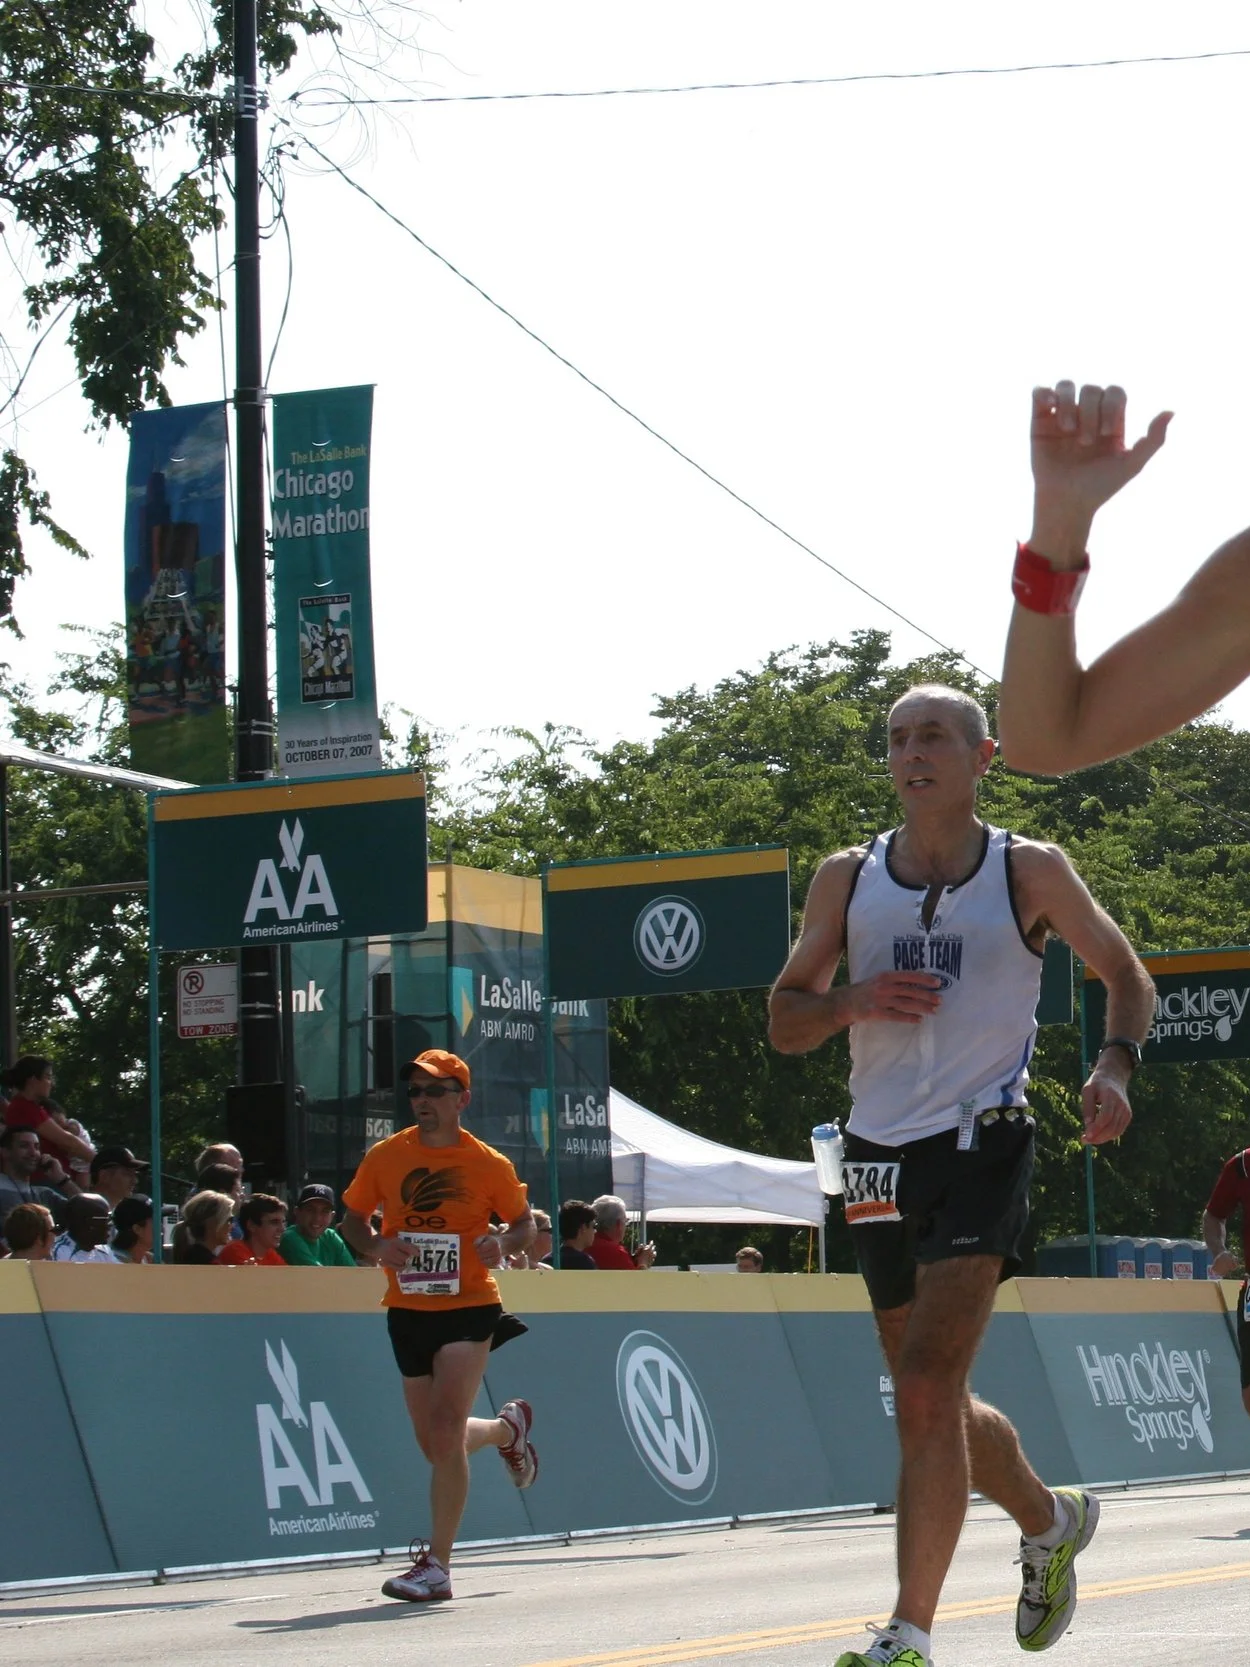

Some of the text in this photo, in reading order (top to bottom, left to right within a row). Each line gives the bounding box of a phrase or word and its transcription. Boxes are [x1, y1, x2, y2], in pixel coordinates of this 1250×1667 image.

[291, 445, 367, 464] The LaSalle Bank
[274, 468, 354, 499] Chicago
[273, 504, 369, 539] Marathon
[285, 732, 373, 750] 30 Years of Inspiration
[286, 745, 373, 763] OCTOBER 07, 2007
[893, 941, 963, 980] PACE TEAM
[480, 974, 542, 1013] LaSalle
[194, 1007, 225, 1015] STANDING
[183, 1024, 235, 1036] TOW ZONE
[480, 1019, 535, 1042] ABN AMRO
[565, 1137, 588, 1155] ABN
[842, 1166, 895, 1204] 1784
[405, 1215, 447, 1229] oe
[1076, 1341, 1211, 1421] Hinckley
[1126, 1406, 1194, 1453] Springs
